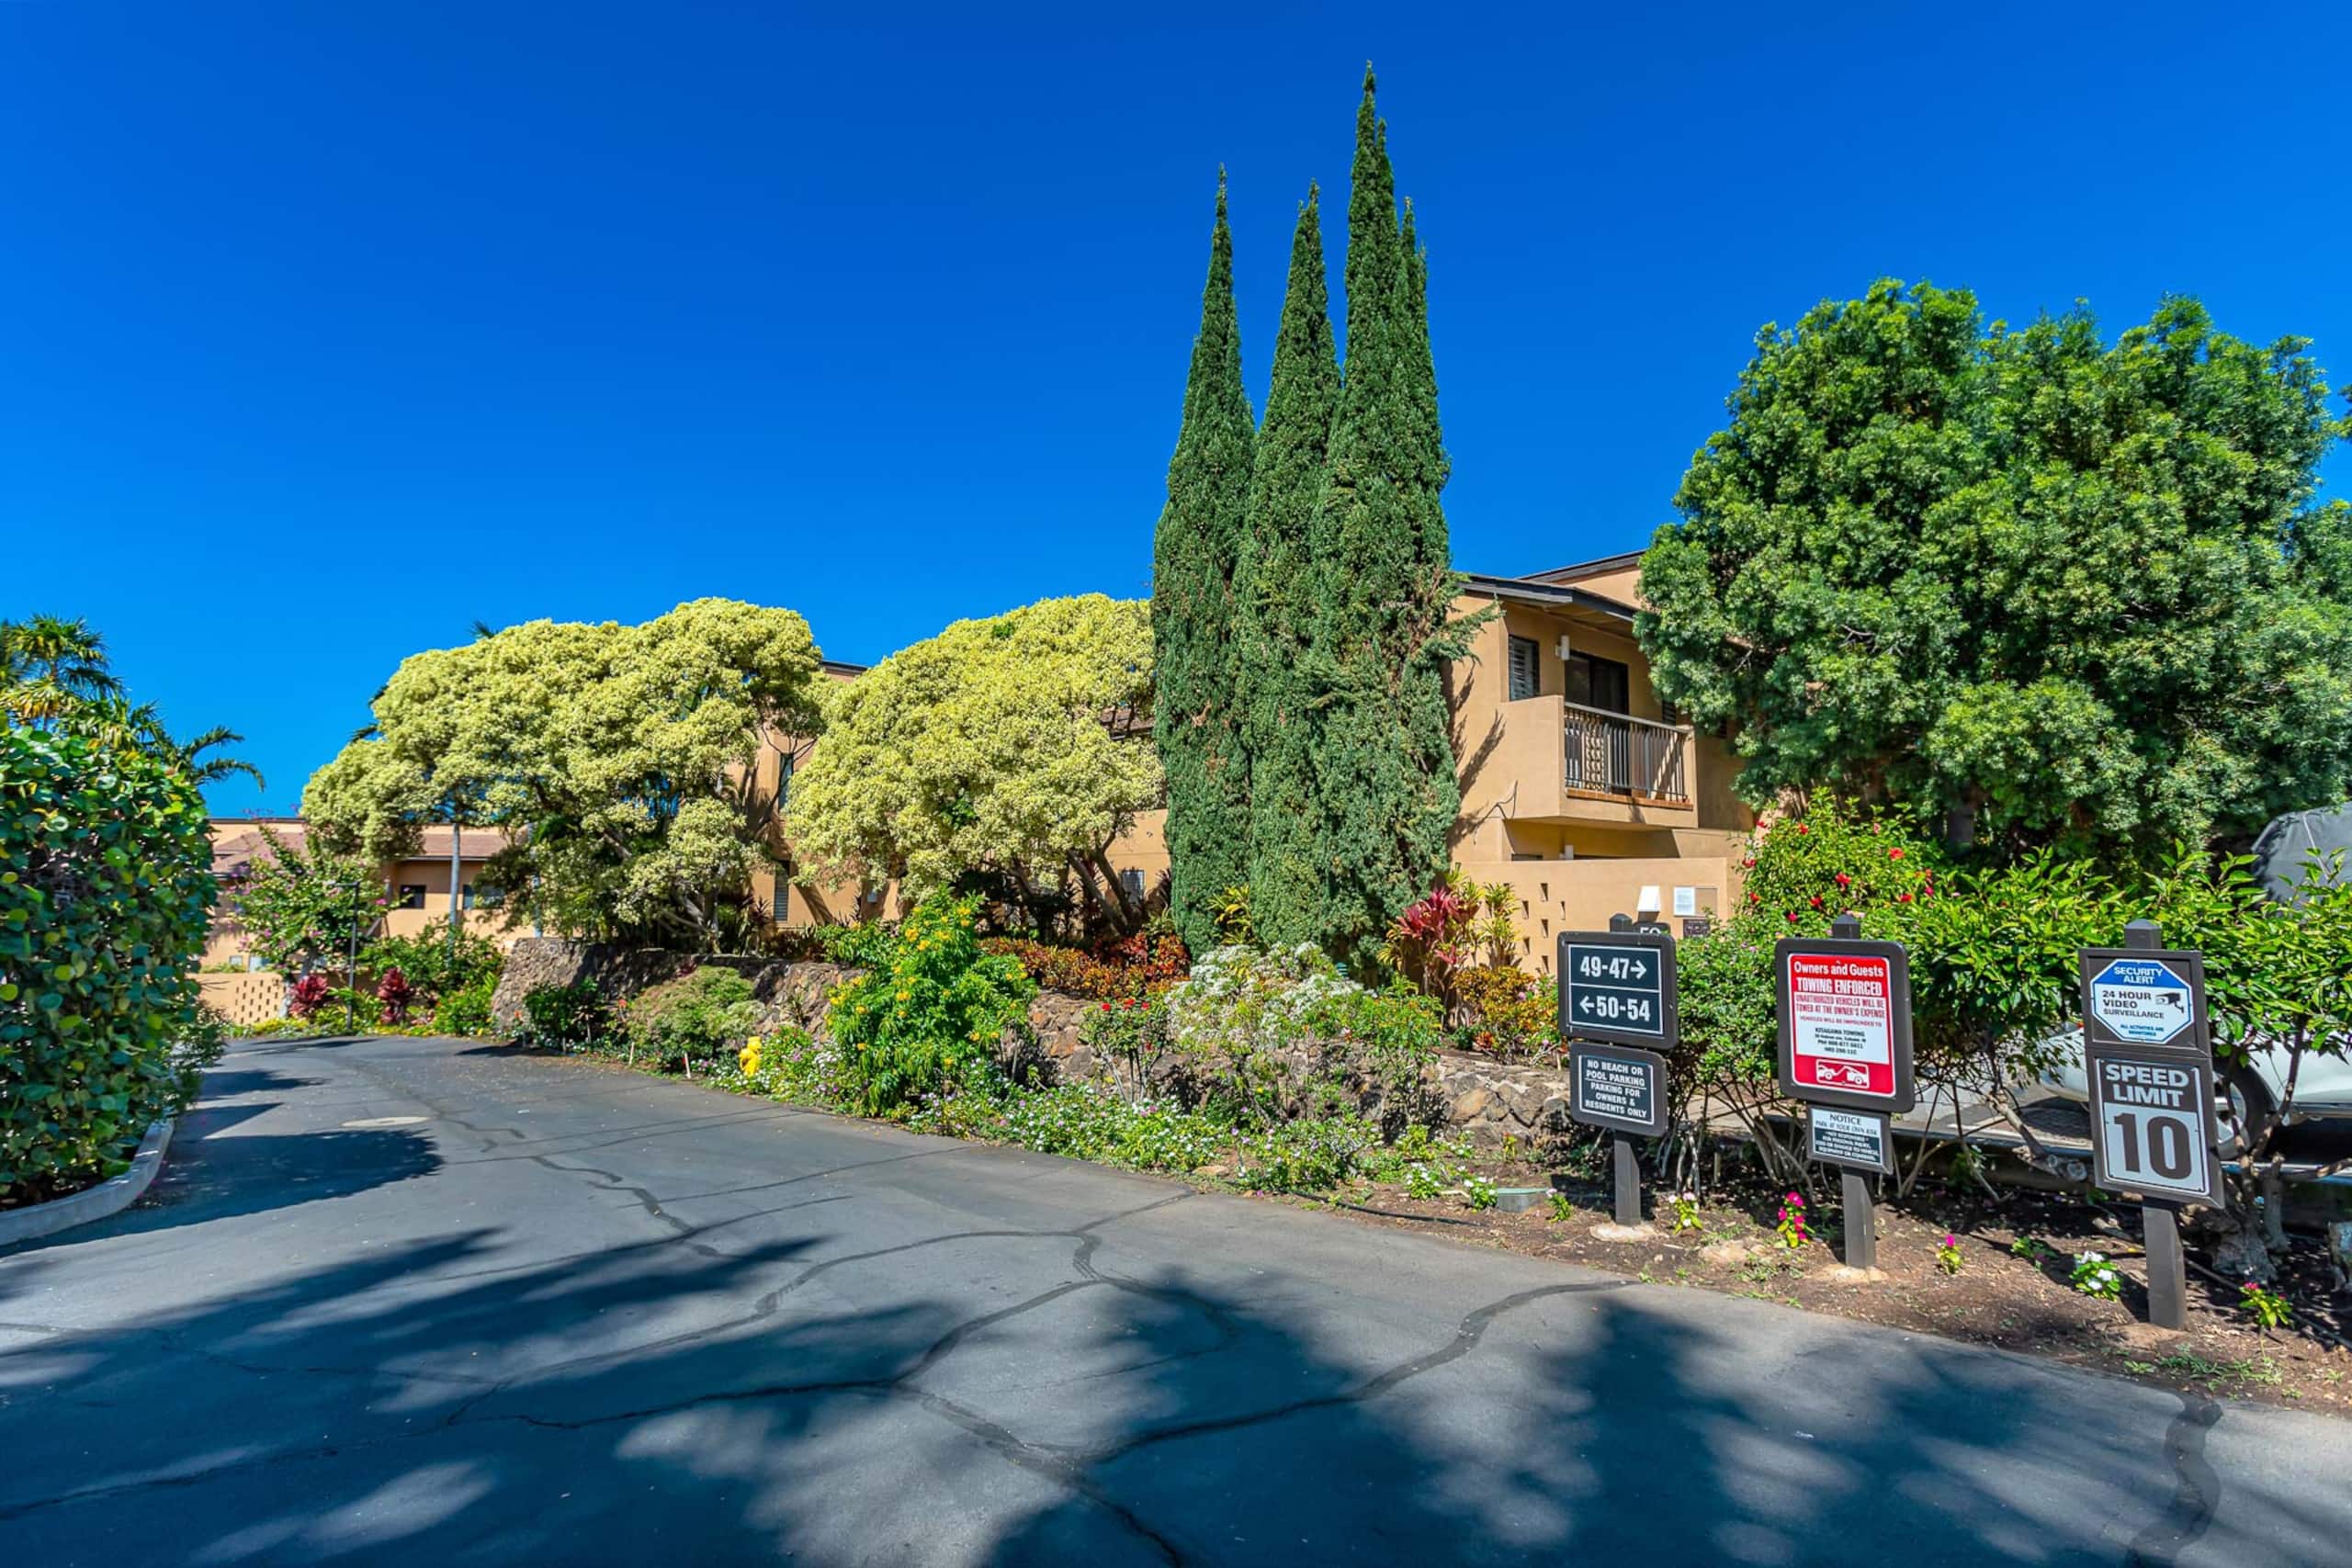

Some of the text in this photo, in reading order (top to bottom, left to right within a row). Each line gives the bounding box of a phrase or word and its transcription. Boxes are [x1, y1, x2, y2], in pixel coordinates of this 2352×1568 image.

[1580, 956, 1629, 979] 49-47
[1794, 961, 1883, 977] Owners and Guests
[2114, 966, 2163, 976] SECURITY
[1796, 976, 1882, 996] TOWING ENFORCED
[2123, 976, 2154, 985] ALERT
[1836, 997, 1860, 1007] VEHICLES
[1862, 999, 1876, 1008] WILL
[1877, 1000, 1883, 1009] BE
[2103, 998, 2138, 1009] VIDEO
[2119, 991, 2152, 1000] HOUR
[1597, 996, 1650, 1021] 50-54
[1796, 1004, 1813, 1012] TOWED
[1815, 1004, 1821, 1013] AT
[1823, 1005, 1832, 1013] THE
[1860, 1008, 1885, 1019] EXPENSE
[2103, 1009, 2165, 1019] SURVEILLANCE
[1588, 1059, 1643, 1076] NO BEACH OR
[1587, 1070, 1645, 1086] POOL PARKING
[2106, 1064, 2188, 1088] SPEED
[1590, 1082, 1640, 1098] PARKING FOR
[2113, 1084, 2184, 1107] LIMIT
[1596, 1092, 1635, 1106] OWNERS &
[1585, 1100, 1646, 1118] RESIDENTS ONLY
[1830, 1113, 1860, 1125] NOTICE
[2114, 1112, 2192, 1179] 10
